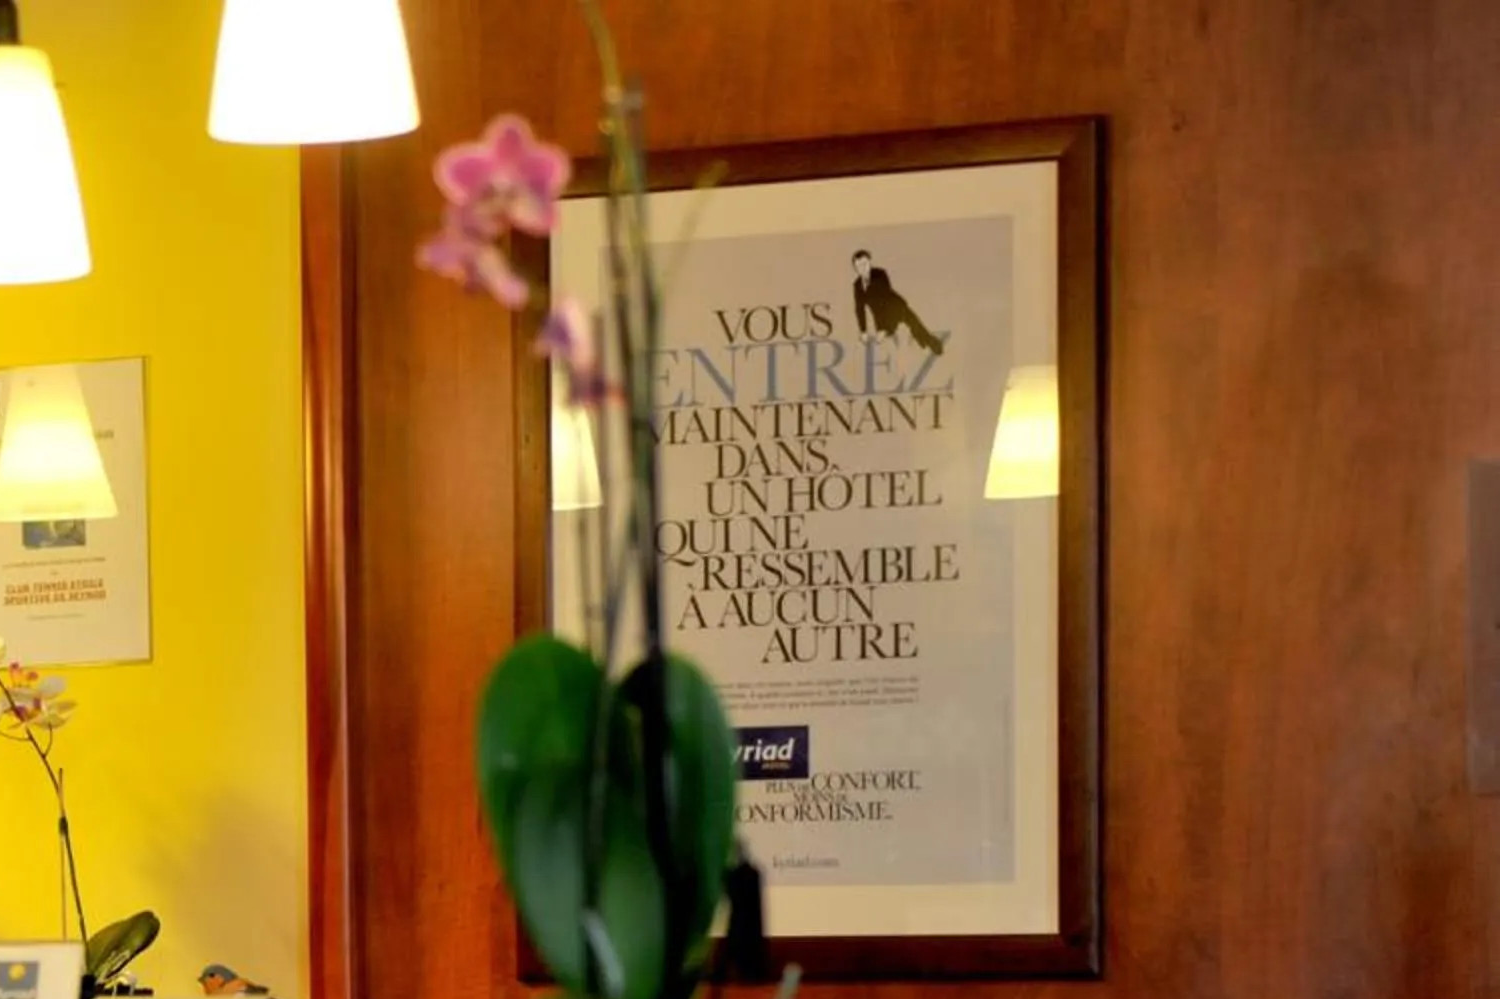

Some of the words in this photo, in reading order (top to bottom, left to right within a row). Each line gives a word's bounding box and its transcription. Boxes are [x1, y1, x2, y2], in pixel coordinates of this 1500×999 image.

[712, 302, 834, 343] VOUS
[714, 438, 830, 479] DANS
[705, 479, 770, 517] UN
[785, 463, 944, 513] HÔTEL
[654, 517, 738, 568] QUI
[747, 513, 809, 551] NE
[701, 544, 961, 591] RESSEMBLE
[677, 583, 709, 630] À
[716, 585, 876, 629] AUCUN
[760, 621, 919, 664] AUTRE
[730, 737, 796, 765] yriad
[735, 800, 895, 825] ONFORMISME.
